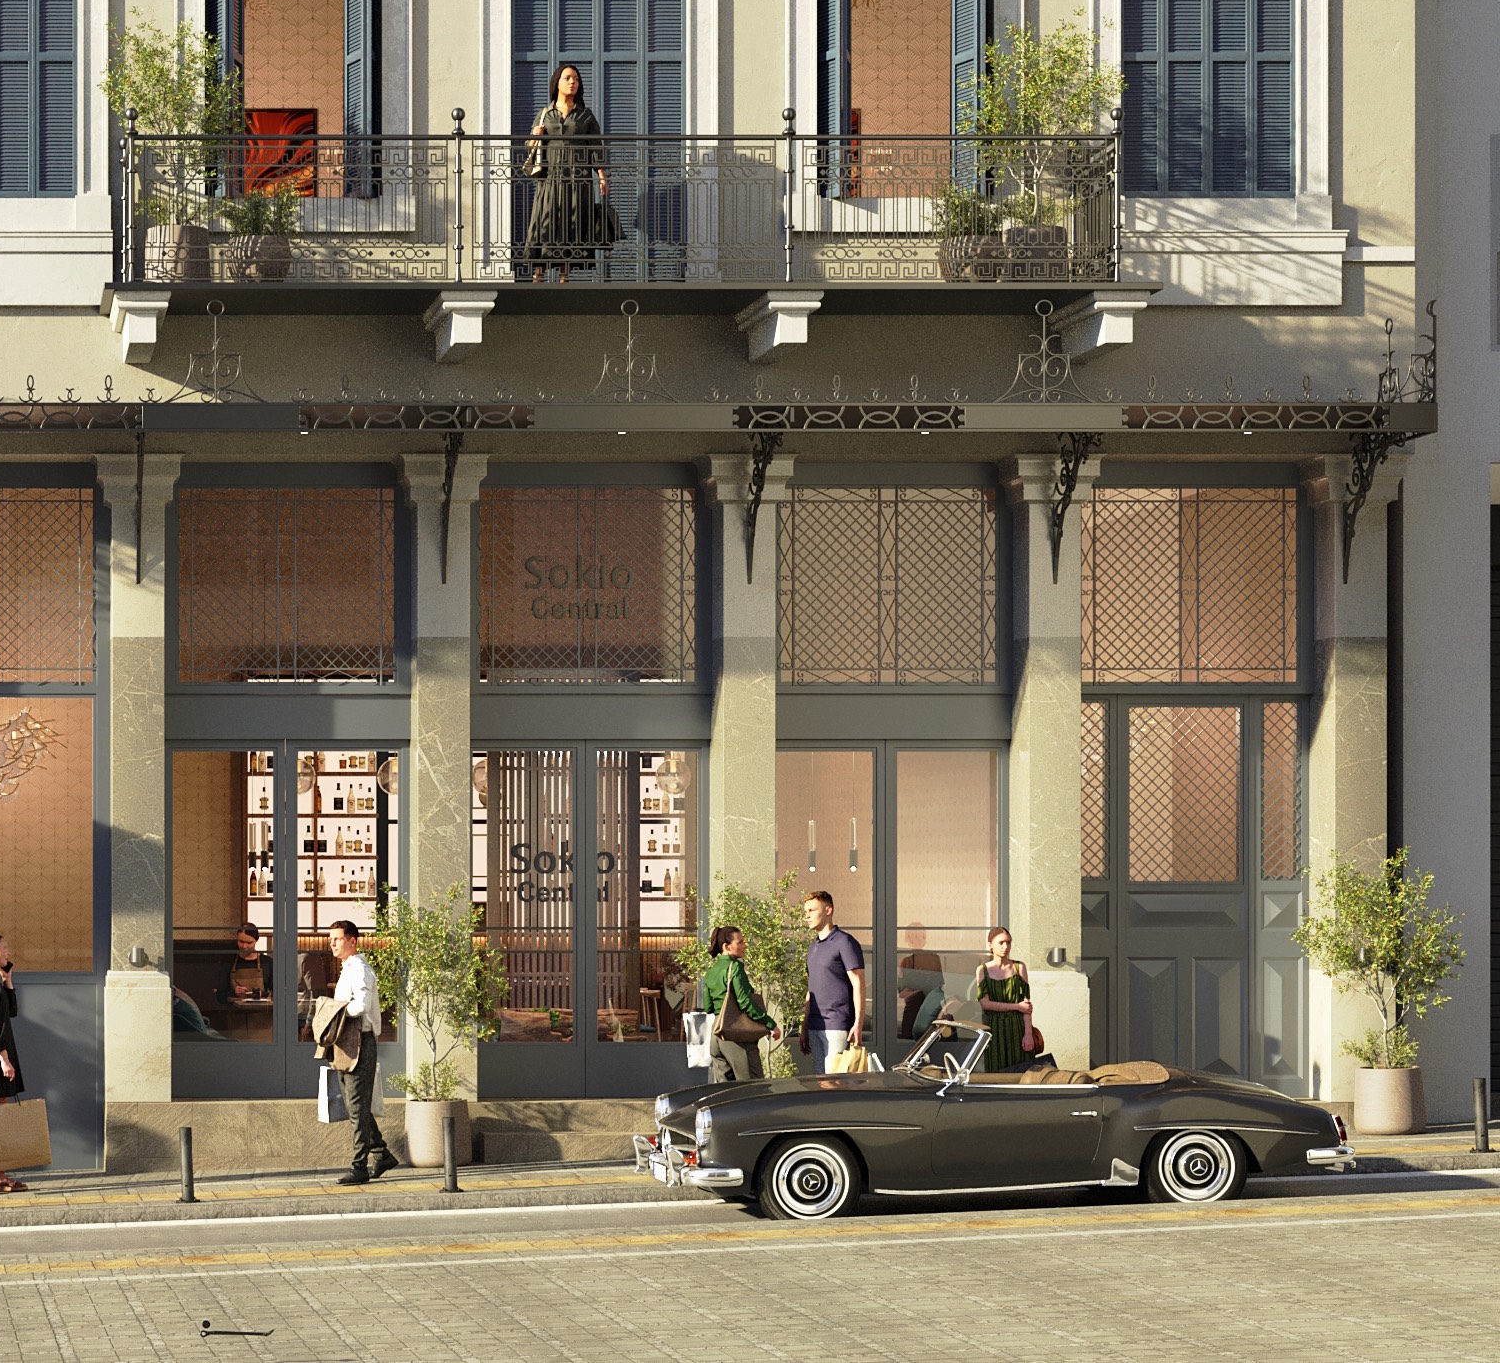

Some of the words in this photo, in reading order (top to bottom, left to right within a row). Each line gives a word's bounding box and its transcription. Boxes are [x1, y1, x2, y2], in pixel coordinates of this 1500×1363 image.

[524, 555, 635, 589] Sokio
[532, 596, 629, 619] Central
[511, 841, 615, 874] Soko
[518, 881, 608, 902] Centl
